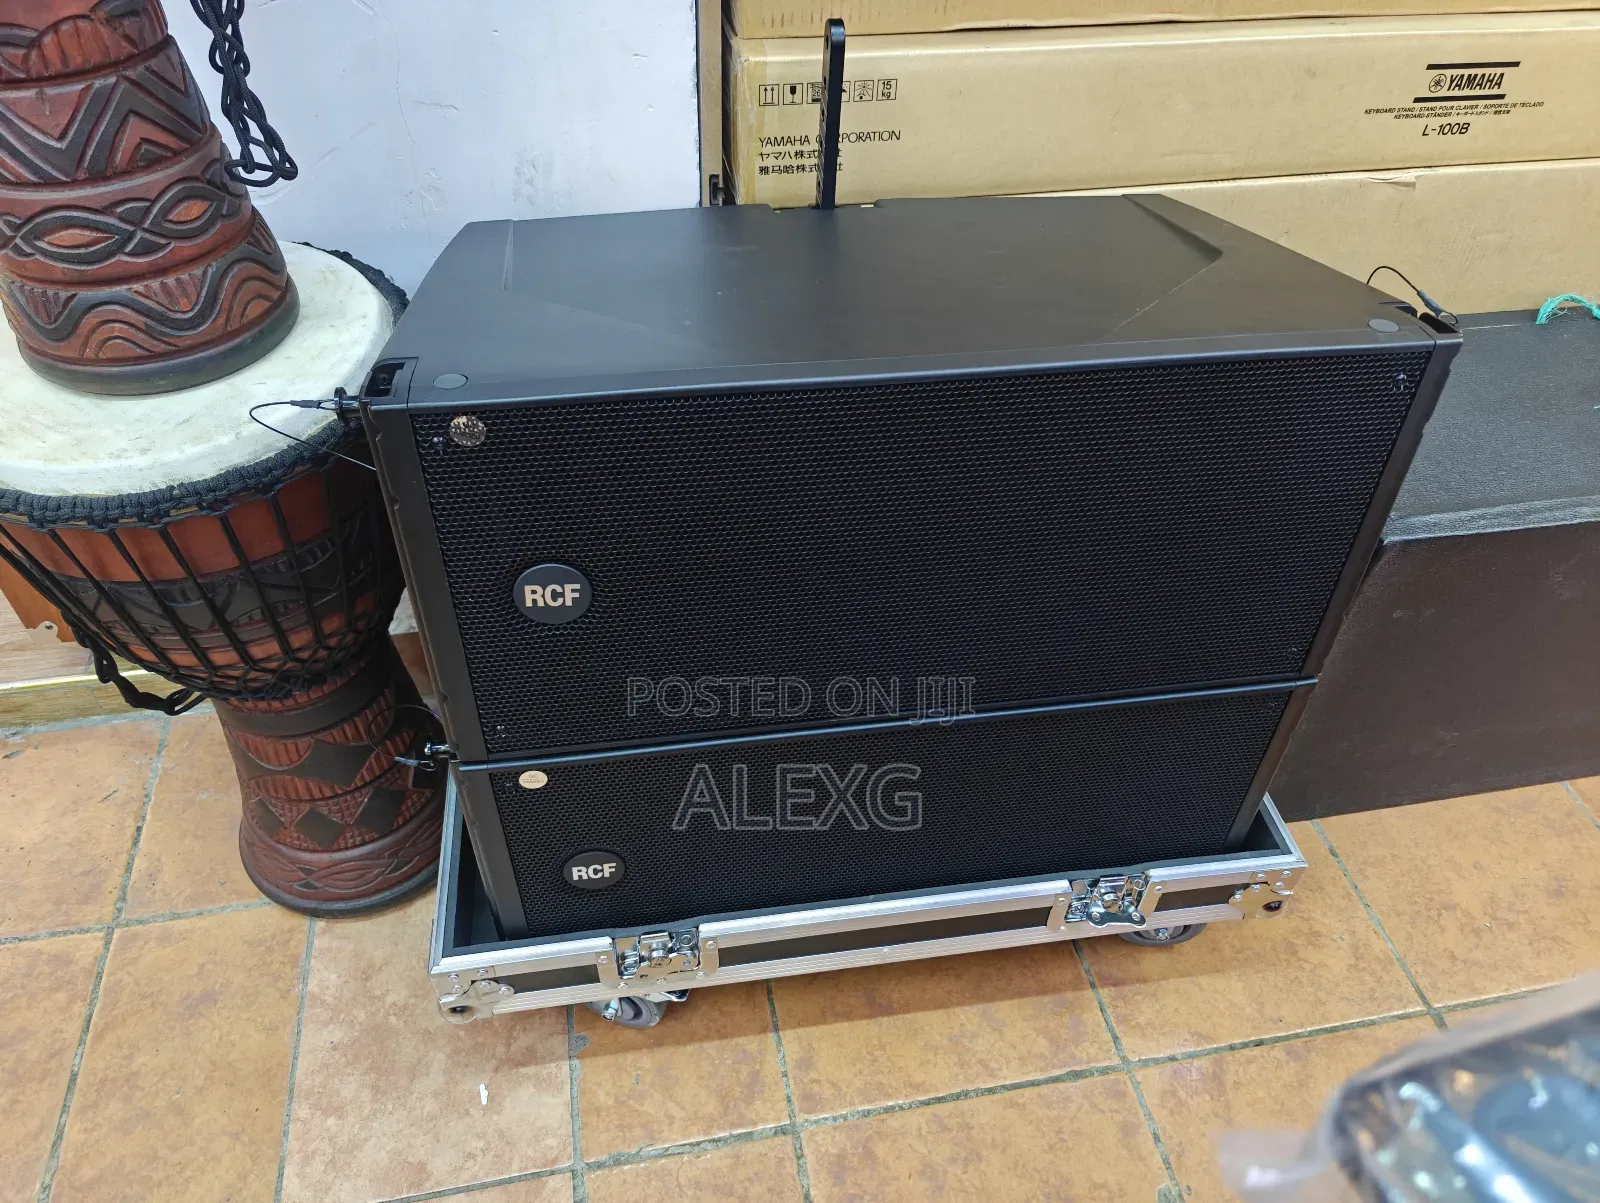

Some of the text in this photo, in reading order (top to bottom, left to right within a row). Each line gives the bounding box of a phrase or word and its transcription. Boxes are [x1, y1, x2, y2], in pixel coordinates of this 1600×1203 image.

[881, 80, 893, 91] 15
[1447, 72, 1505, 92] YAMAHA
[881, 90, 892, 99] kg
[1364, 107, 1396, 115] KEYBOARD
[1483, 102, 1510, 110] SOPORTE
[1422, 122, 1471, 137] L-100B
[758, 130, 901, 148] YAMAHA PORATION
[758, 148, 843, 161] ヤマハ株式
[758, 161, 844, 176] 雅马哈株式
[524, 583, 581, 608] RCF
[571, 862, 617, 881] RCF
